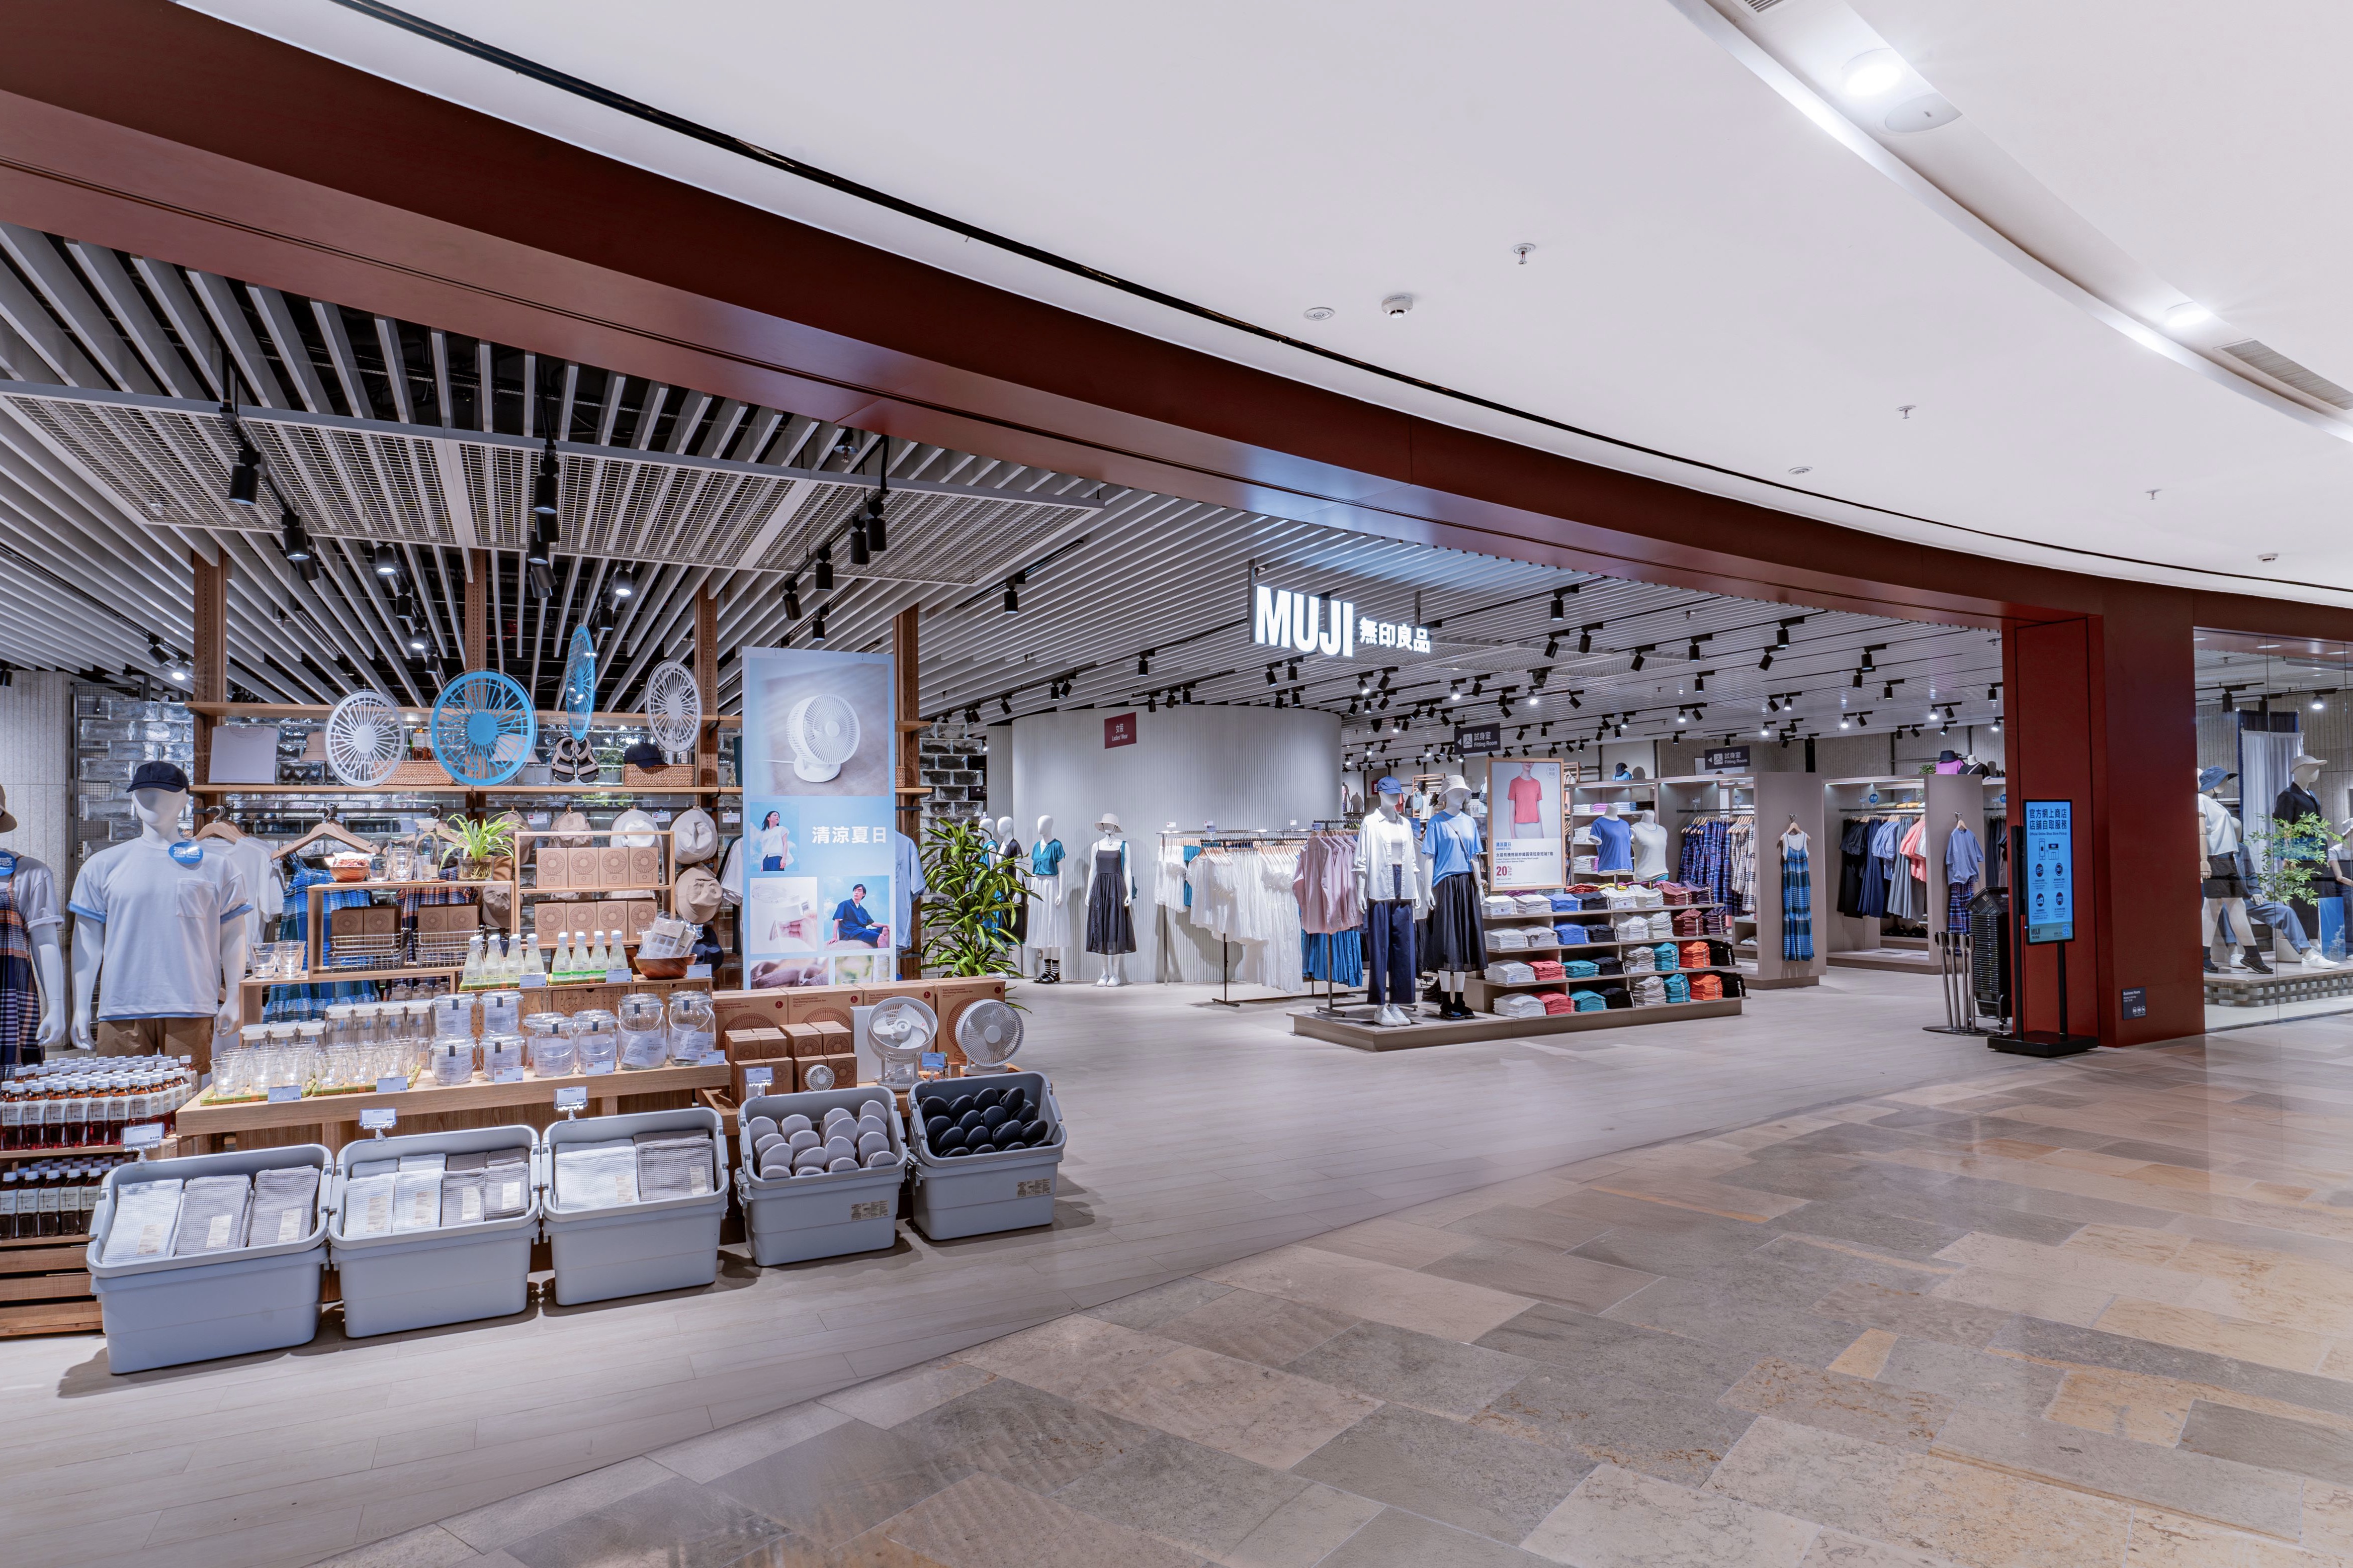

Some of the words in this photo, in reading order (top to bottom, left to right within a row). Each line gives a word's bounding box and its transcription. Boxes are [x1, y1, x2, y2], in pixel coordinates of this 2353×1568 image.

[1255, 585, 1353, 657] MUJI
[1359, 616, 1430, 654] 無印良品
[1115, 723, 1124, 733] 女裝
[1474, 731, 1491, 741] 試身室
[2029, 808, 2067, 819] 官方網上商店
[812, 826, 886, 844] 清涼夏日
[1496, 866, 1507, 876] 20
